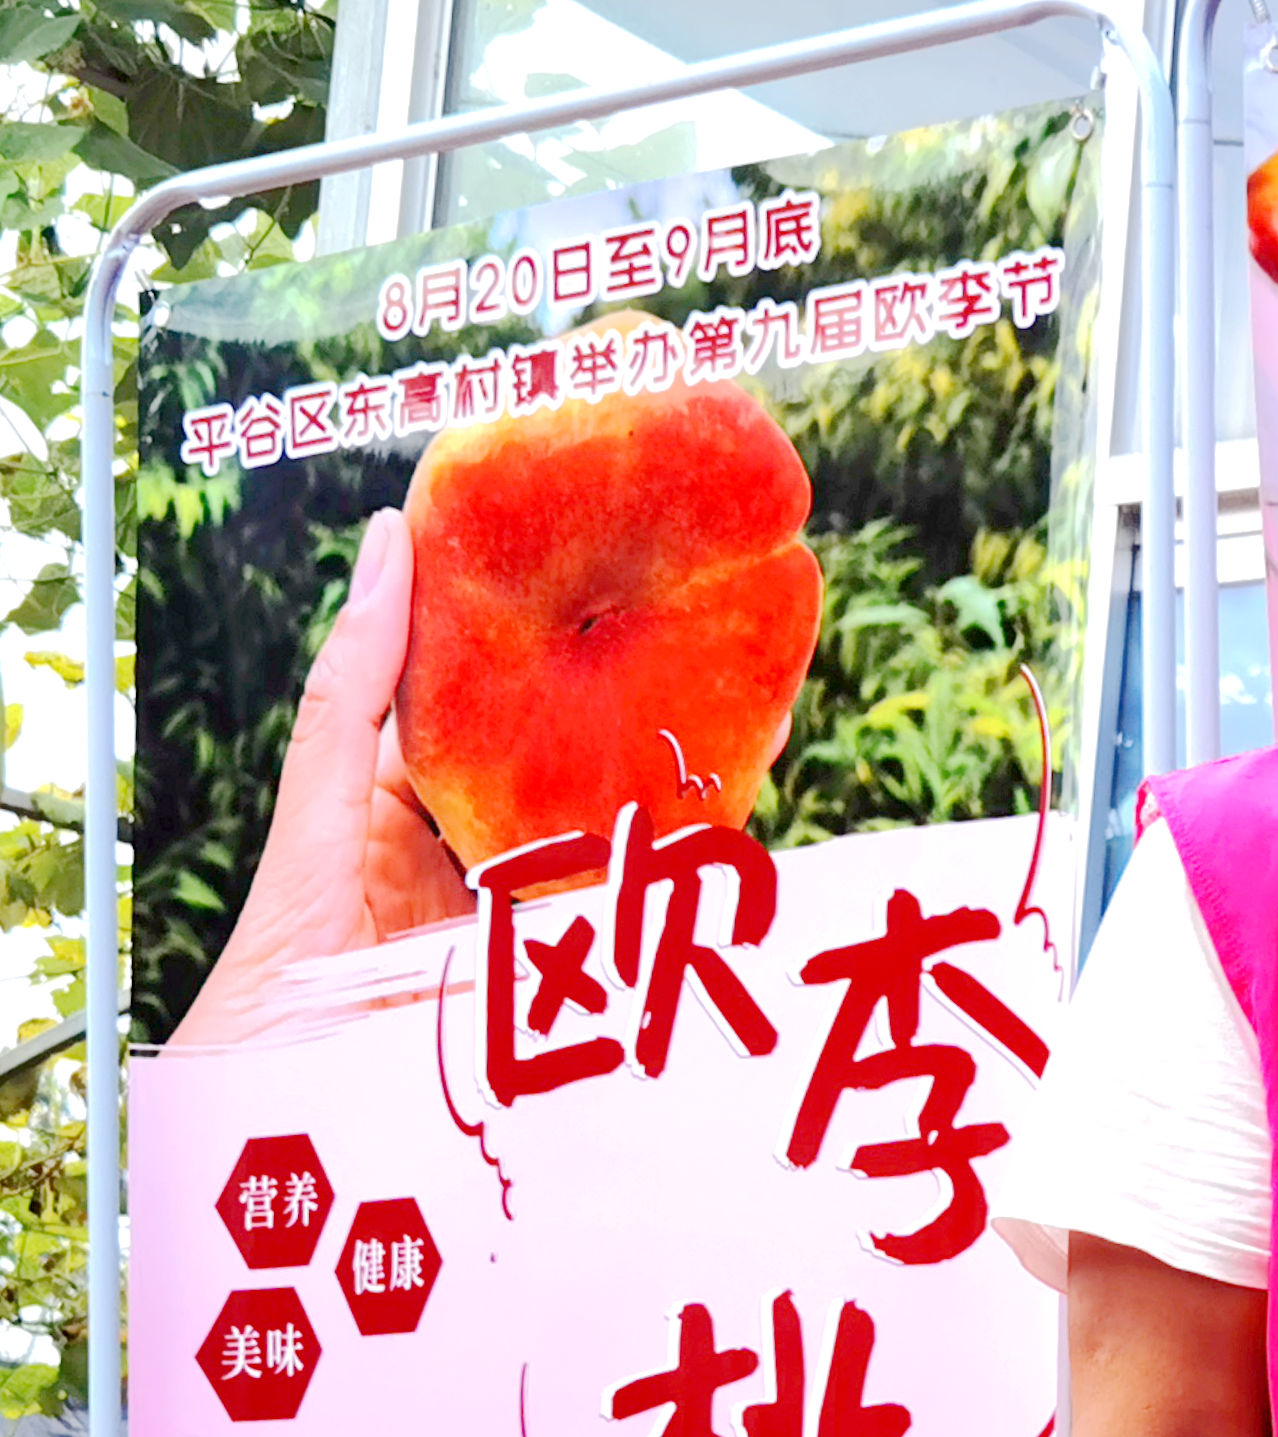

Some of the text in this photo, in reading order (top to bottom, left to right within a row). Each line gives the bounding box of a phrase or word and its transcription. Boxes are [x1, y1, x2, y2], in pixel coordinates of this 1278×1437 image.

[380, 198, 820, 336] 8月20日至9月底
[184, 250, 1062, 470] 平谷区东高村镇举办第九届欧李节
[238, 1170, 319, 1232] 营养
[352, 1233, 425, 1296] 健康
[220, 1321, 305, 1381] 美味
